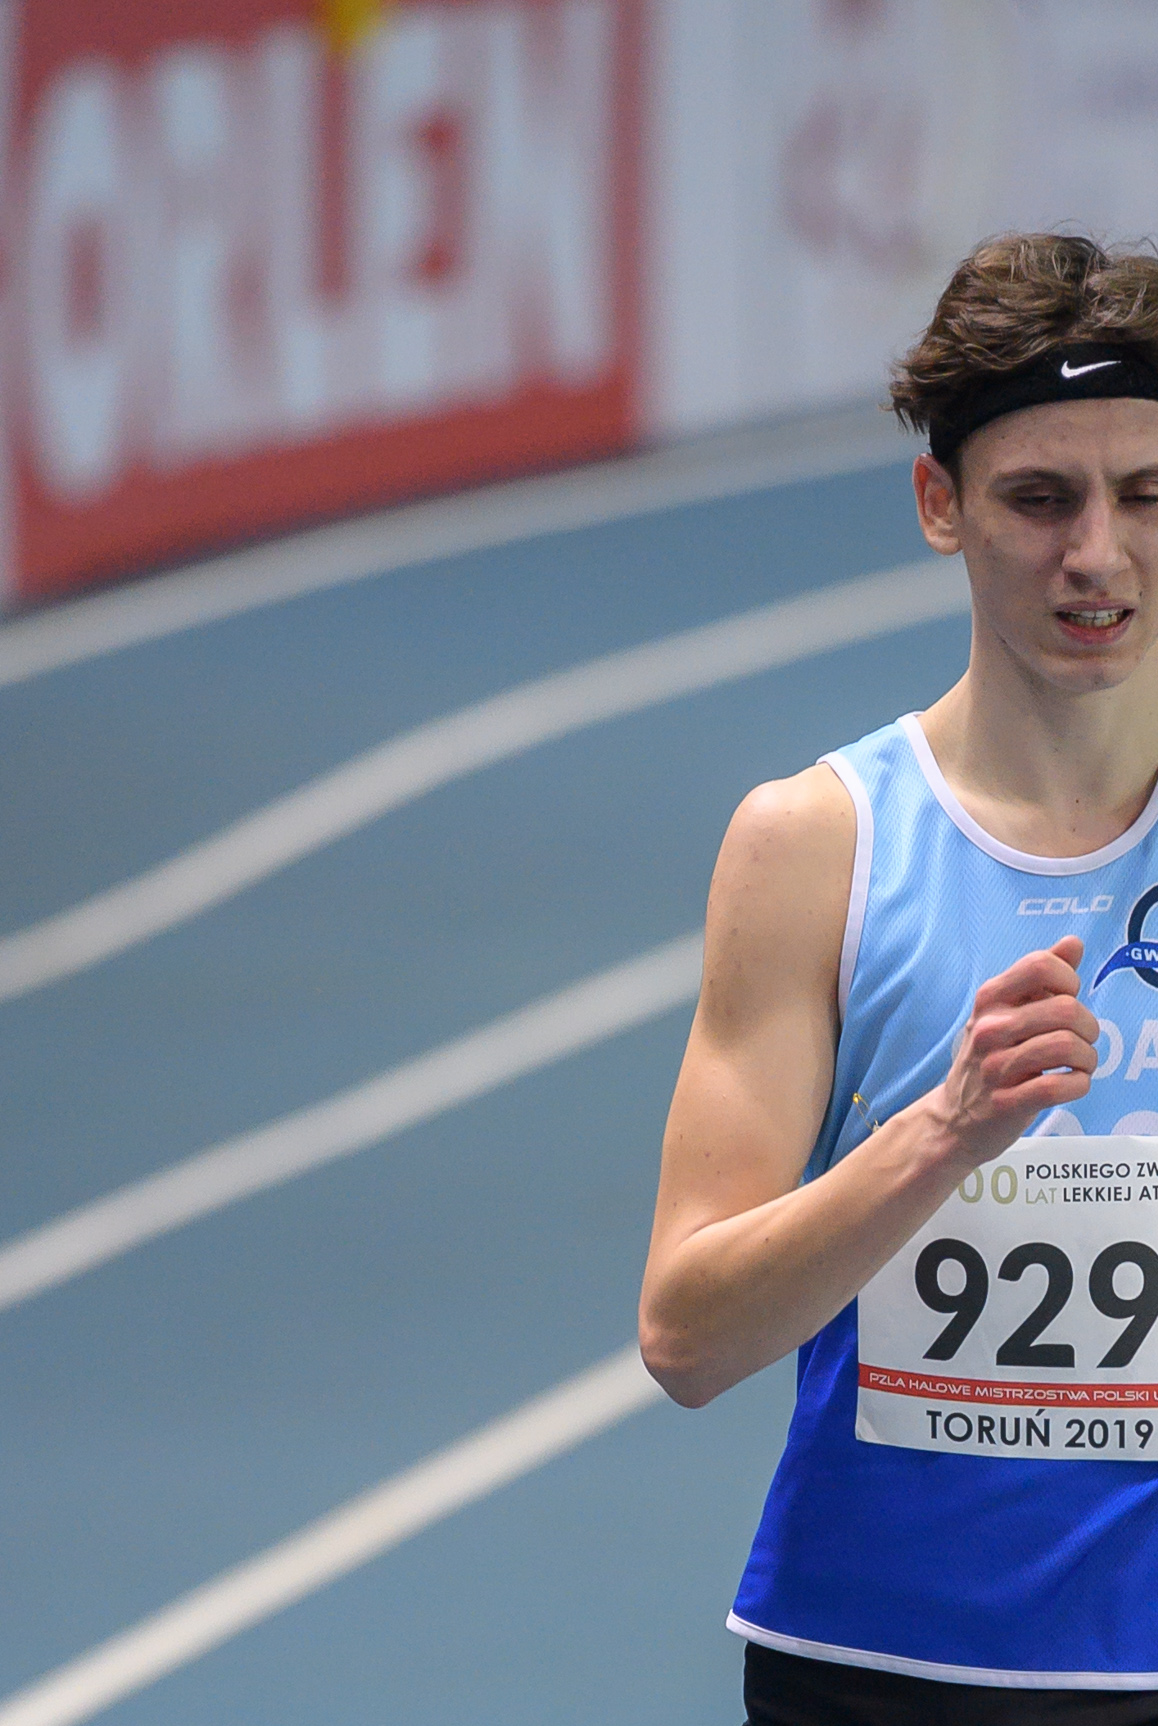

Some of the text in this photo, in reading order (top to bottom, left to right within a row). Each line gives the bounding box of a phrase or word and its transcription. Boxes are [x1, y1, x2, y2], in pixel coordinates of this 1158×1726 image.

[28, 5, 608, 502] ORLEN
[957, 1165, 1019, 1205] 00
[1025, 1163, 1131, 1180] POLSKIEGO
[1025, 1187, 1058, 1204] LAT
[1062, 1186, 1132, 1203] LEKKIEJ
[869, 1372, 906, 1389] PZLA
[908, 1379, 971, 1397] HALOWE
[974, 1386, 1091, 1401] MISTRZOSTWA
[1093, 1390, 1150, 1402] POLSKI
[926, 1408, 1155, 1449] TORUŃ 2019
